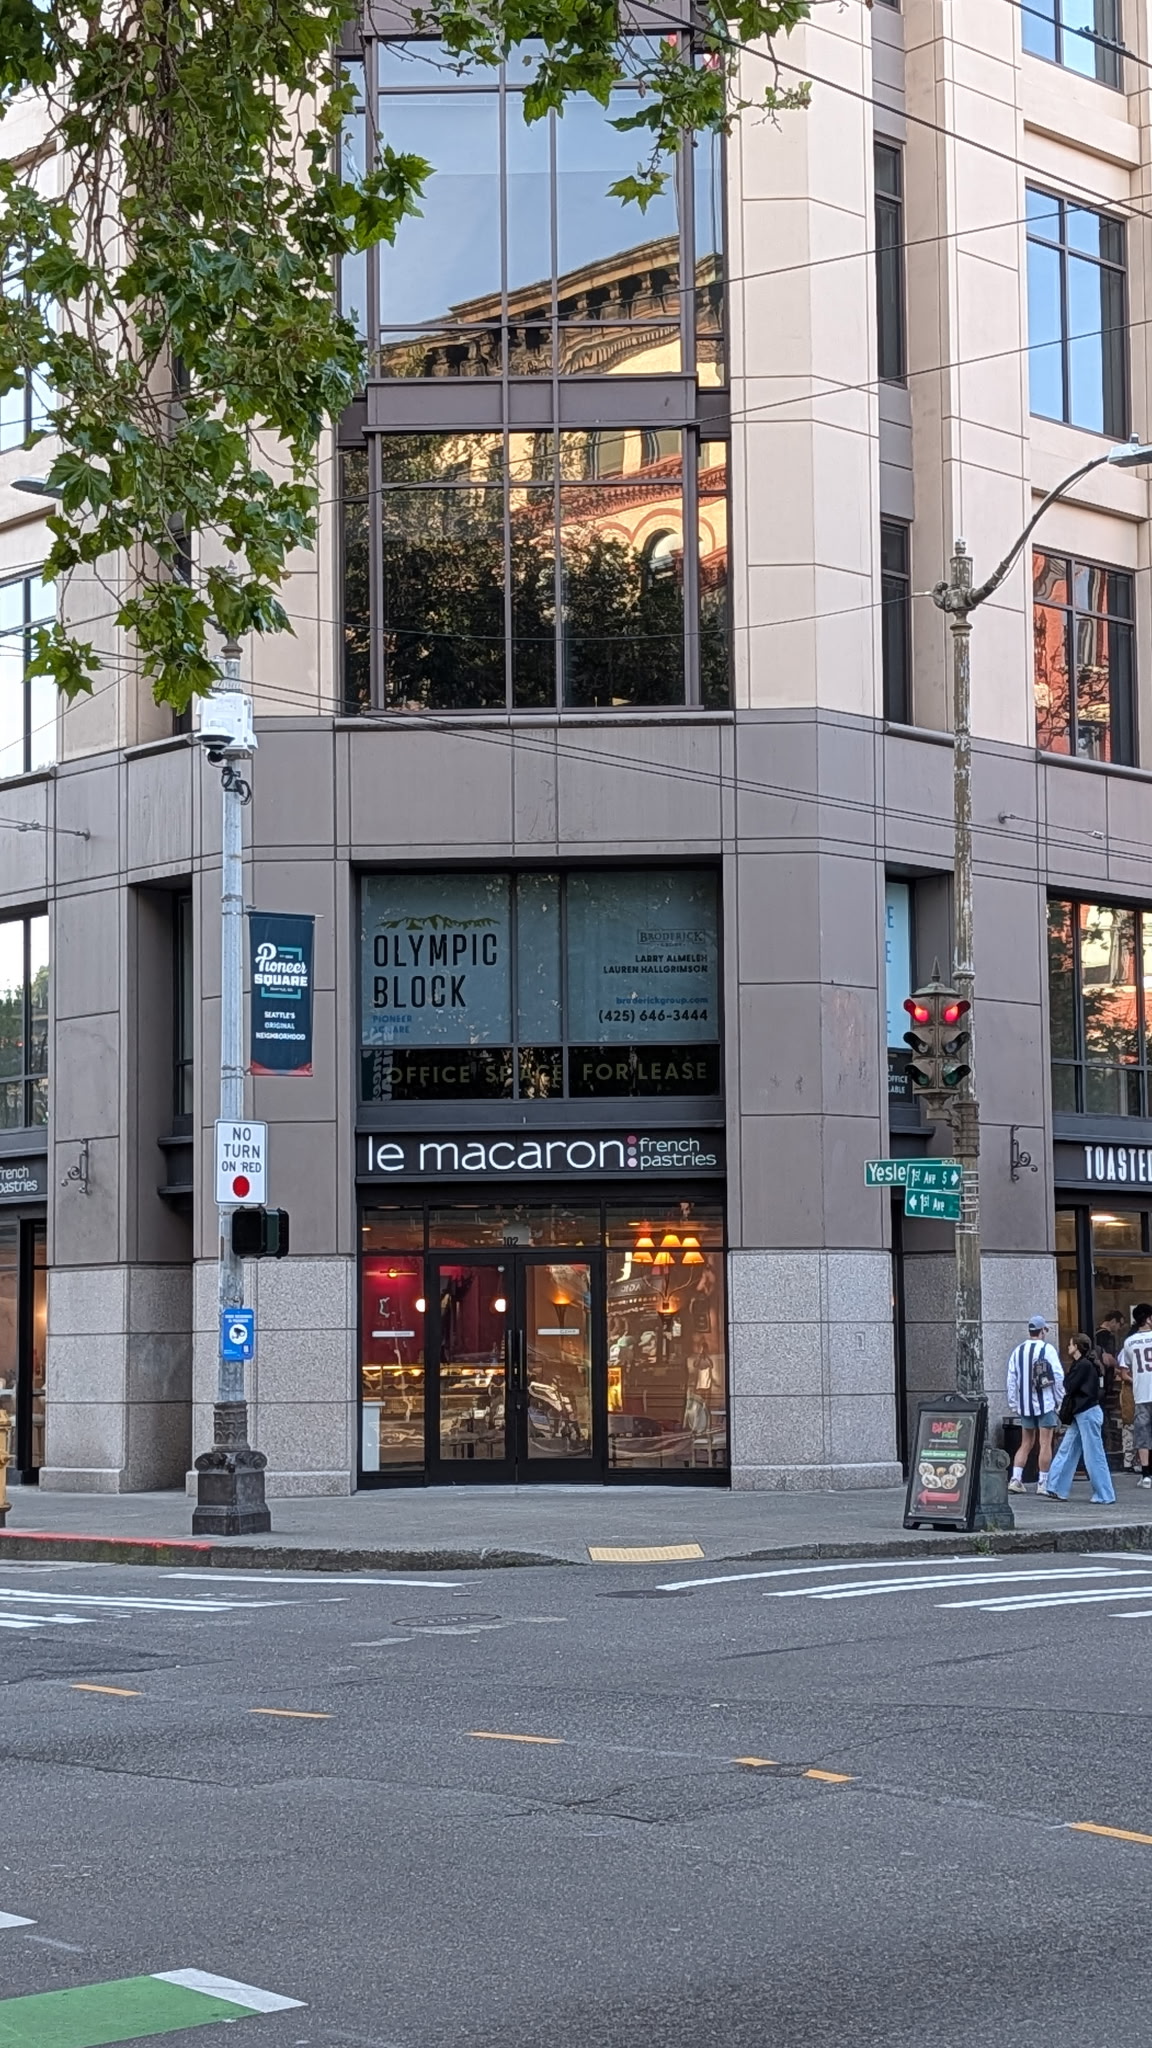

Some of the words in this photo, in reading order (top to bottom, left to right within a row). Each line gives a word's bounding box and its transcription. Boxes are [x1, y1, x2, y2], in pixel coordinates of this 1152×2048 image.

[640, 931, 705, 942] BRODERICK
[373, 933, 497, 967] OLYMPIC
[254, 942, 308, 974] Pioneer
[635, 955, 664, 963] LARRY
[666, 954, 708, 963] ALMELEH
[603, 966, 638, 974] LAUREN
[640, 965, 708, 974] HALLGRIMSON
[254, 973, 308, 987] SQUARE
[373, 975, 466, 1008] BLOCK
[616, 996, 709, 1005] broderickgroup.com
[373, 1015, 412, 1023] PIONEER
[598, 1010, 635, 1023] (425)
[639, 1010, 708, 1022] 646-3444
[385, 1066, 470, 1084] OFFICE
[582, 1062, 629, 1081] FOR
[637, 1062, 707, 1080] LEASE
[232, 1127, 252, 1141] NO
[223, 1143, 261, 1159] TURN
[638, 1137, 700, 1153] french
[368, 1136, 405, 1171] le
[419, 1139, 625, 1171] macaron
[221, 1161, 237, 1172] ON
[241, 1161, 262, 1173] RED
[639, 1152, 717, 1171] pastries
[868, 1163, 906, 1181] Yesle
[923, 1171, 937, 1184] Ave
[941, 1170, 948, 1185] S
[932, 1197, 945, 1212] Ave
[503, 1236, 519, 1247] 102
